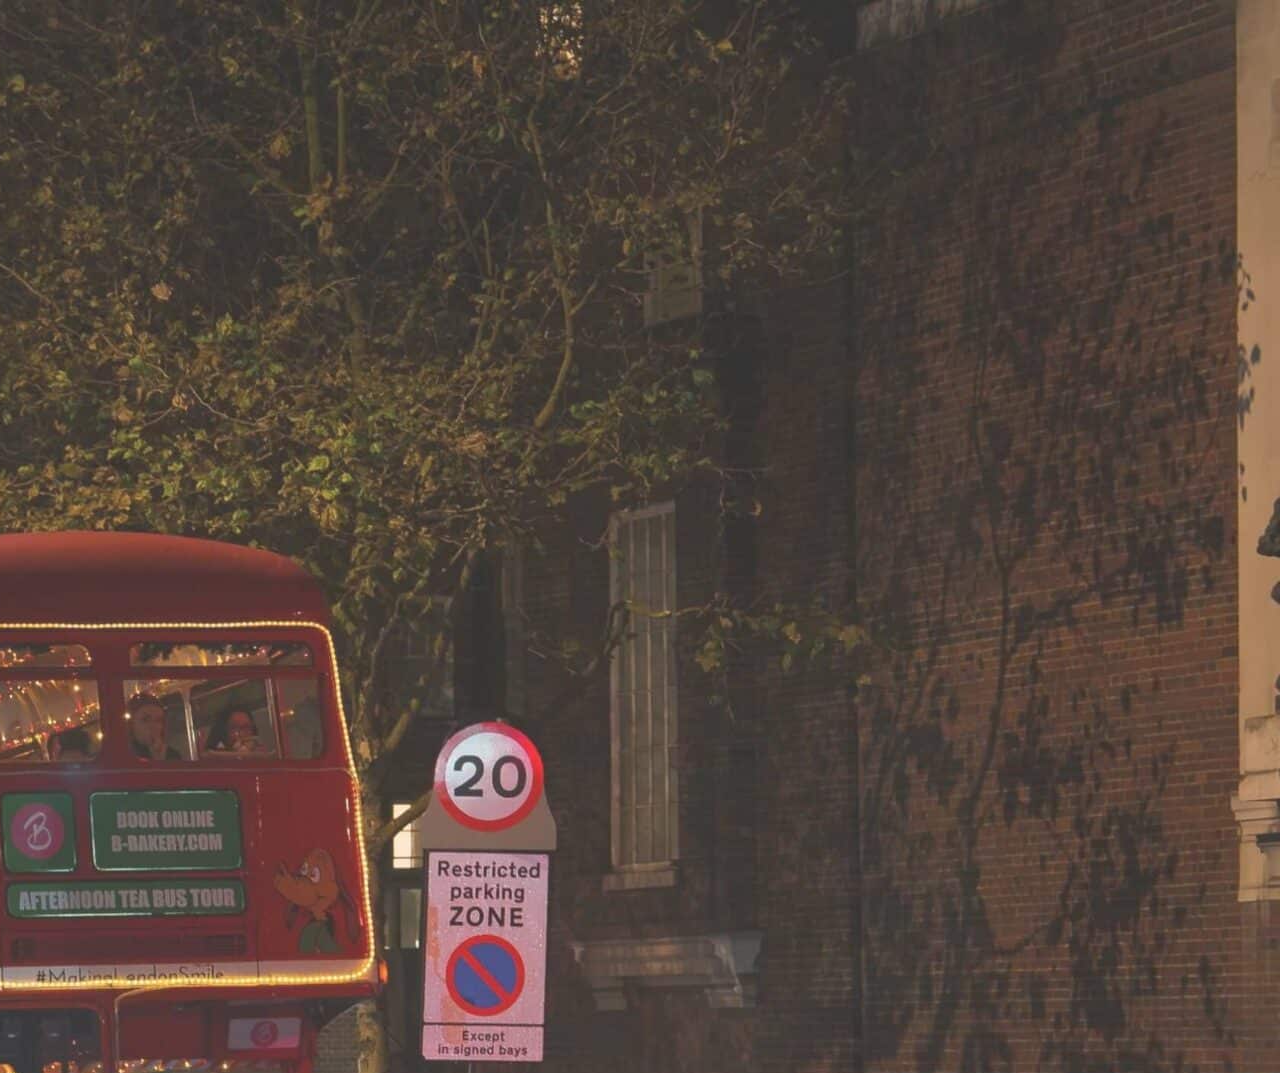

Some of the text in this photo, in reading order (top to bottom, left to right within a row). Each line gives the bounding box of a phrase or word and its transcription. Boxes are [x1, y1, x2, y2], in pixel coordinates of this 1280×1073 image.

[453, 755, 527, 798] 20
[116, 810, 215, 828] BOOK ONLINE
[111, 833, 223, 852] B-BAKERY.COM
[438, 861, 541, 879] Restricted
[19, 888, 235, 911] AFTERNOON TEA BUS TOUR
[450, 883, 525, 904] parking
[449, 907, 524, 927] ZONE
[462, 1030, 505, 1043] Except
[438, 1044, 528, 1057] in signed bays
